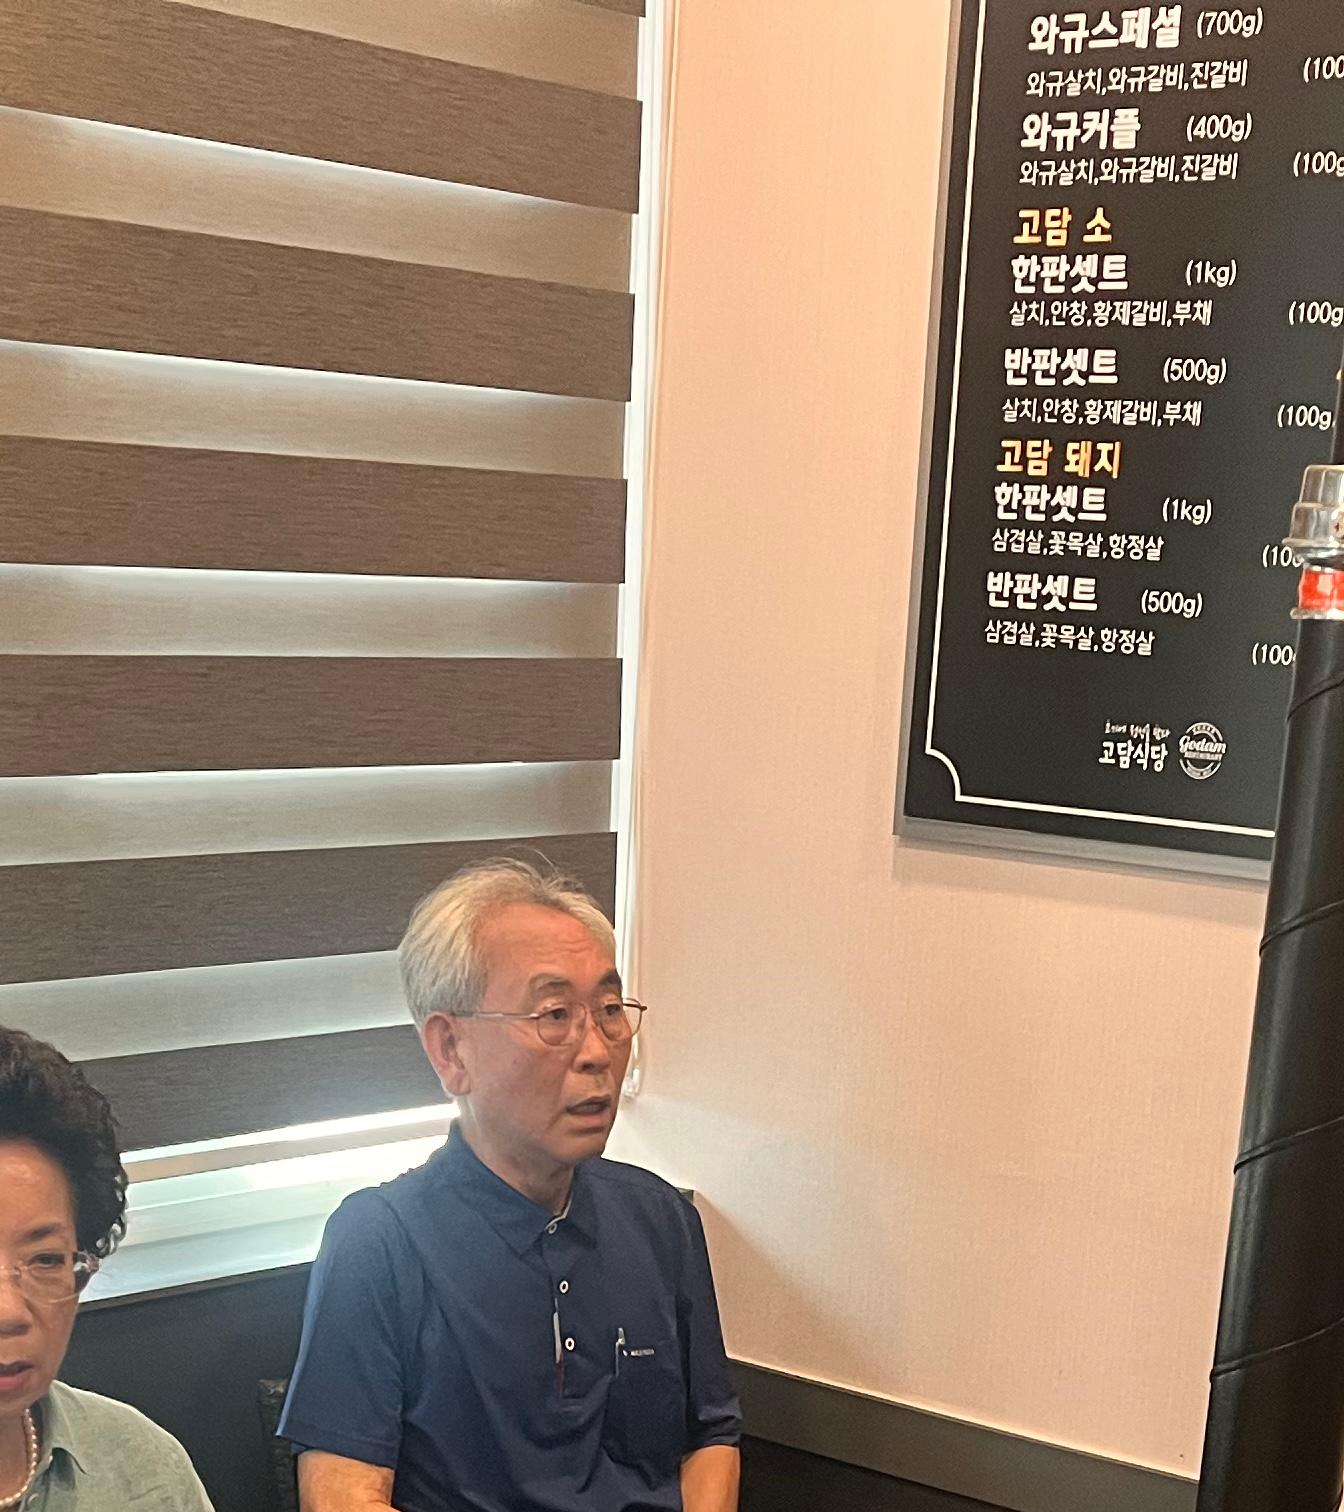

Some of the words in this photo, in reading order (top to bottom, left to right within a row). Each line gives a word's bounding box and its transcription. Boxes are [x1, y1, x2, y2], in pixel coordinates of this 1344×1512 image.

[1029, 5, 1181, 55] 와규스페셜
[1197, 8, 1262, 38] (700g)
[1026, 59, 1247, 97] 와규살치,와규갈비,진갈비
[1021, 109, 1140, 151] 와규커플
[1187, 113, 1251, 141] (400g)
[1020, 153, 1238, 185] 와규살치,와규갈비,진갈비
[1014, 207, 1071, 246] 고담
[1083, 208, 1111, 242] 소
[1012, 254, 1127, 293] 한판셋트
[1186, 260, 1236, 287] (1kg)
[1010, 300, 1212, 327] 살치,안창,황제갈비,부채
[1005, 348, 1117, 385] 반판셋트
[1164, 358, 1226, 385] (500g)
[1003, 398, 1201, 426] 살치,안창,황제갈비,부채
[997, 440, 1052, 476] 고담
[1065, 441, 1120, 478] 돼지
[995, 483, 1106, 522] 한판셋트
[1163, 498, 1211, 525] (1kg)
[993, 529, 1163, 560] 삼겹살,꽃목살,항정살
[988, 572, 1097, 611] 반판셋트
[1142, 590, 1202, 618] (500g)
[985, 621, 1154, 655] 삼겹살,꽃목살,항정살
[1099, 735, 1167, 771] 고담식당
[1179, 735, 1227, 754] Godam
